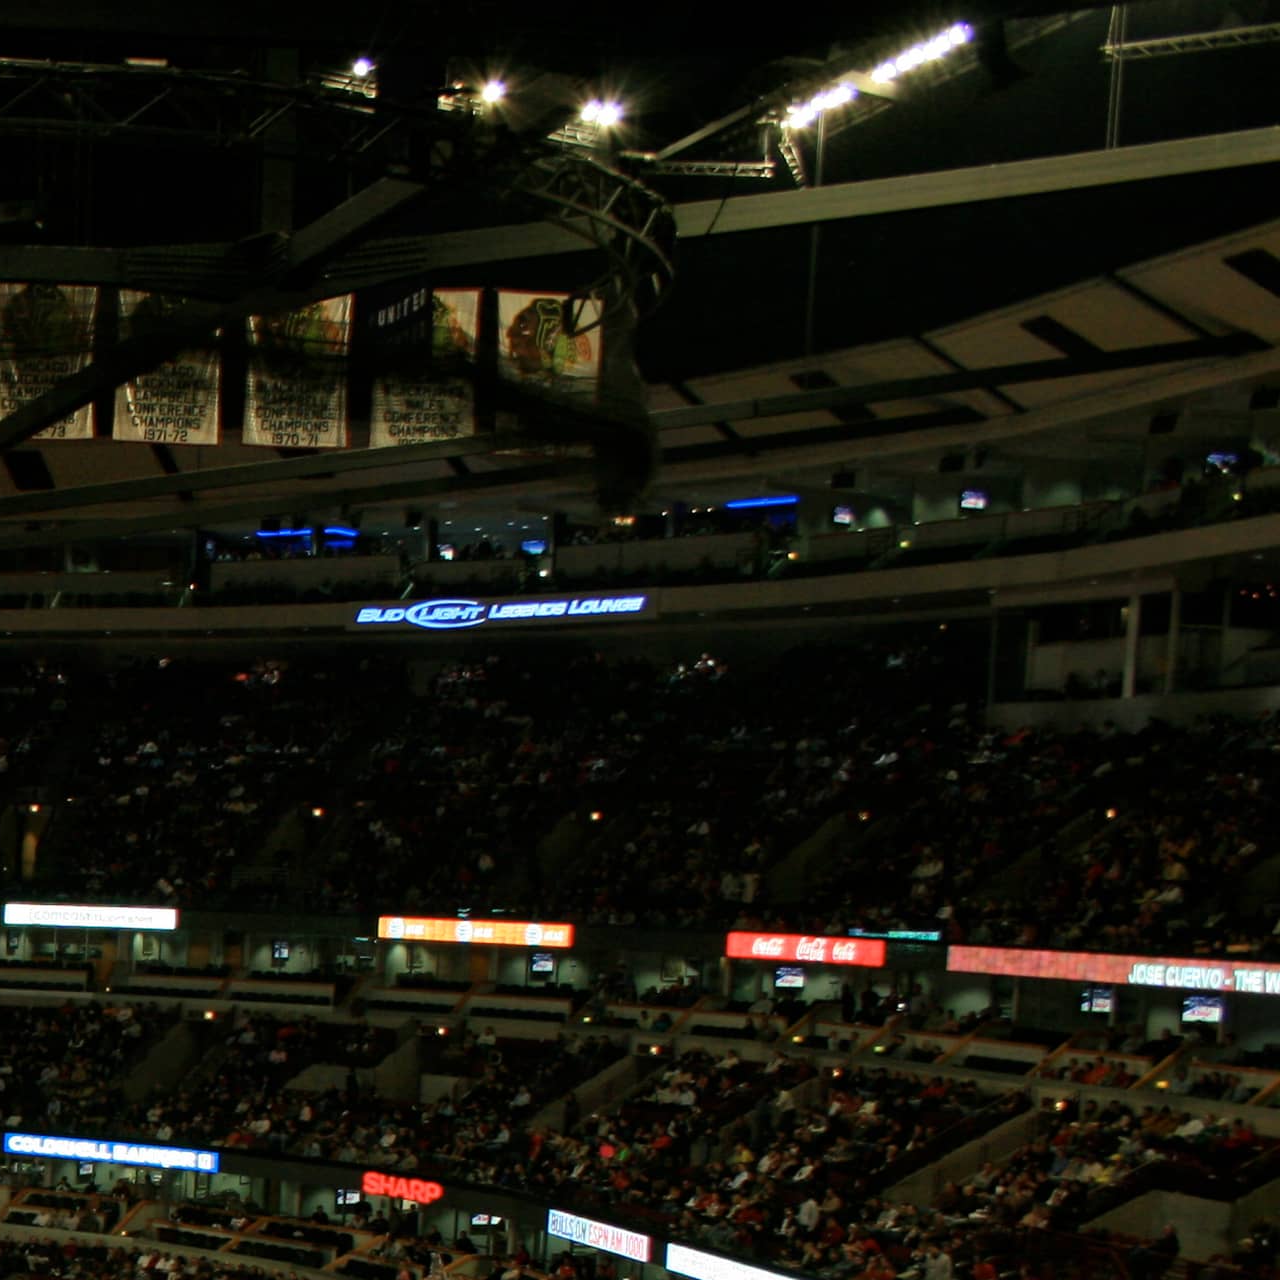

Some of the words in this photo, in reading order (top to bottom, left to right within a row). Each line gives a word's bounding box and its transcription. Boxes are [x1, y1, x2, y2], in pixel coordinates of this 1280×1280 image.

[130, 416, 202, 429] CHAMPIONS
[356, 608, 405, 623] BUD
[422, 606, 486, 621] LIGHT
[568, 596, 646, 615] LOUNGE
[1128, 962, 1164, 985] JOSE
[1165, 965, 1221, 990] CUERVO
[1233, 968, 1264, 992] THE
[6, 1135, 110, 1161] COLDWELL
[362, 1171, 445, 1205] SHARP
[550, 1212, 574, 1238] BULLS
[575, 1218, 587, 1241] ON
[589, 1223, 609, 1248] ESPN
[610, 1229, 623, 1251] AM
[625, 1233, 646, 1259] 1000
